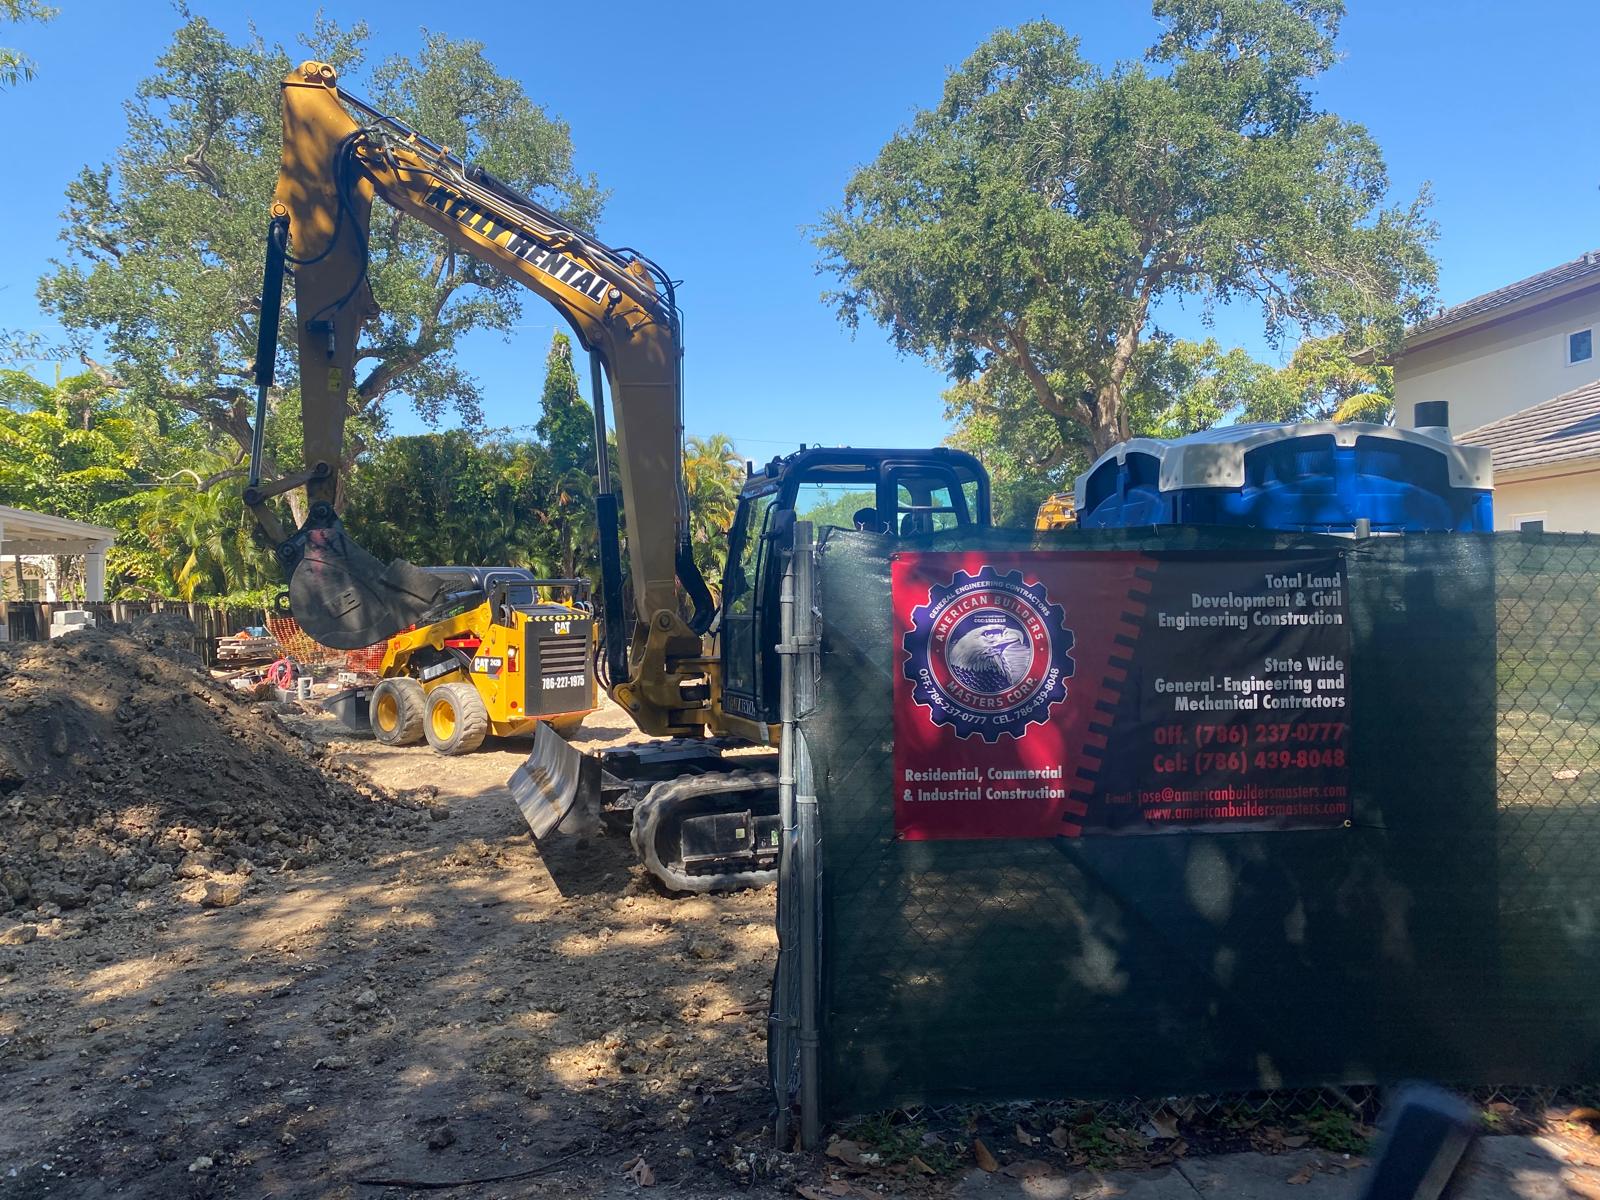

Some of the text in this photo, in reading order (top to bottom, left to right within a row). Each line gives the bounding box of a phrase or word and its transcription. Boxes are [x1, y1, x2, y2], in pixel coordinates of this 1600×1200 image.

[425, 185, 610, 302] KELLY RENTAL
[1265, 572, 1341, 589] Total Land
[929, 580, 1050, 619] GENERAL ENGINEERING CONTRACTORS
[1192, 590, 1342, 611] Development & Civil
[554, 621, 571, 634] CAT
[936, 595, 1044, 642] AMERICAN BUILDERS
[1158, 609, 1343, 631] Engineering Construction
[474, 657, 489, 672] CAT
[1264, 655, 1344, 673] State Wide
[946, 676, 1038, 708] MASTERS CORP.
[1317, 674, 1345, 690] and
[1014, 667, 1060, 719] 786-439-8048
[1175, 694, 1346, 711] Mechanical Contractors
[927, 687, 988, 725] 786-237-0777
[1154, 722, 1346, 747] Off. (786) 237-0777
[1153, 749, 1345, 774] Cel: (786) 439-8048
[905, 765, 1063, 783] Residential, Commercial
[903, 785, 1066, 802] & Industrial Construction
[1144, 802, 1346, 820] www.americanbuildersmasters.com
